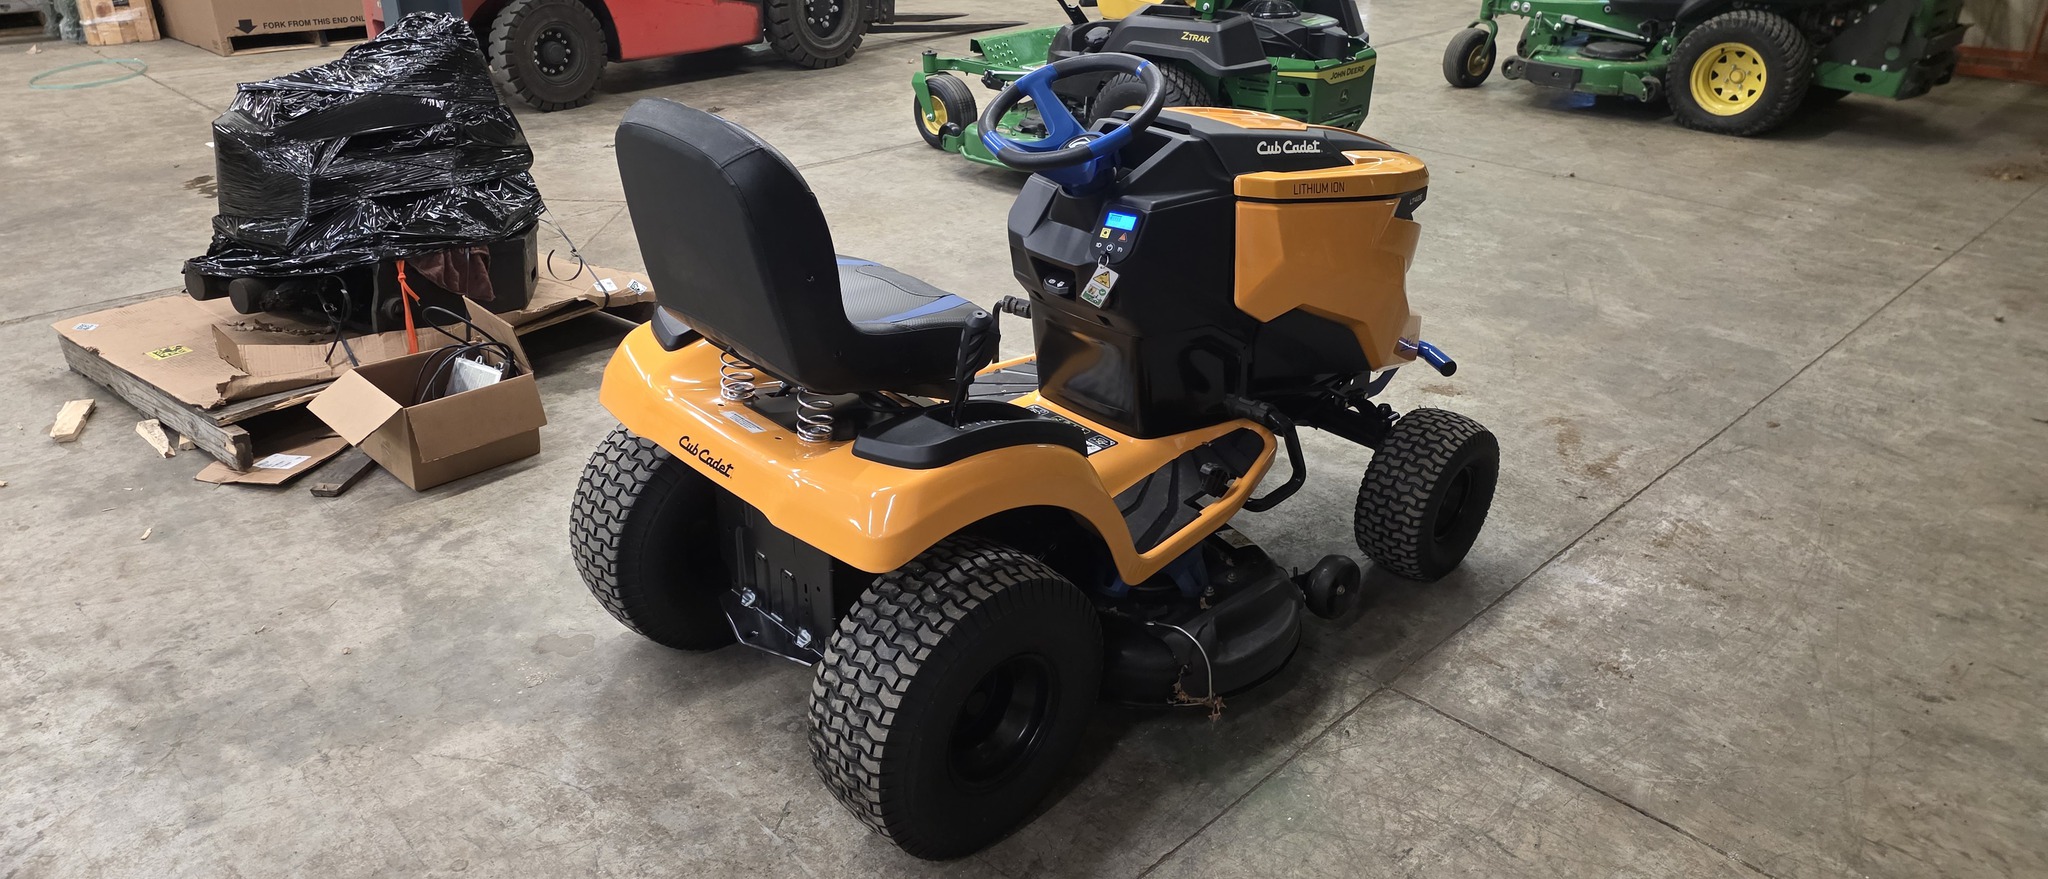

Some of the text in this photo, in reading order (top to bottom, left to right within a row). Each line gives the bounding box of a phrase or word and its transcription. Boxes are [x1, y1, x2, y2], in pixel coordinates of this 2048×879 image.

[312, 18, 331, 26] THIS
[333, 16, 349, 24] END
[350, 15, 365, 23] ONL
[1181, 31, 1210, 43] ZTRAK
[1330, 65, 1365, 79] JOHN DEERE
[1257, 139, 1321, 155] Cub Cadet
[1293, 181, 1345, 195] LITHIUM ION
[679, 435, 734, 478] Cub Cadet
